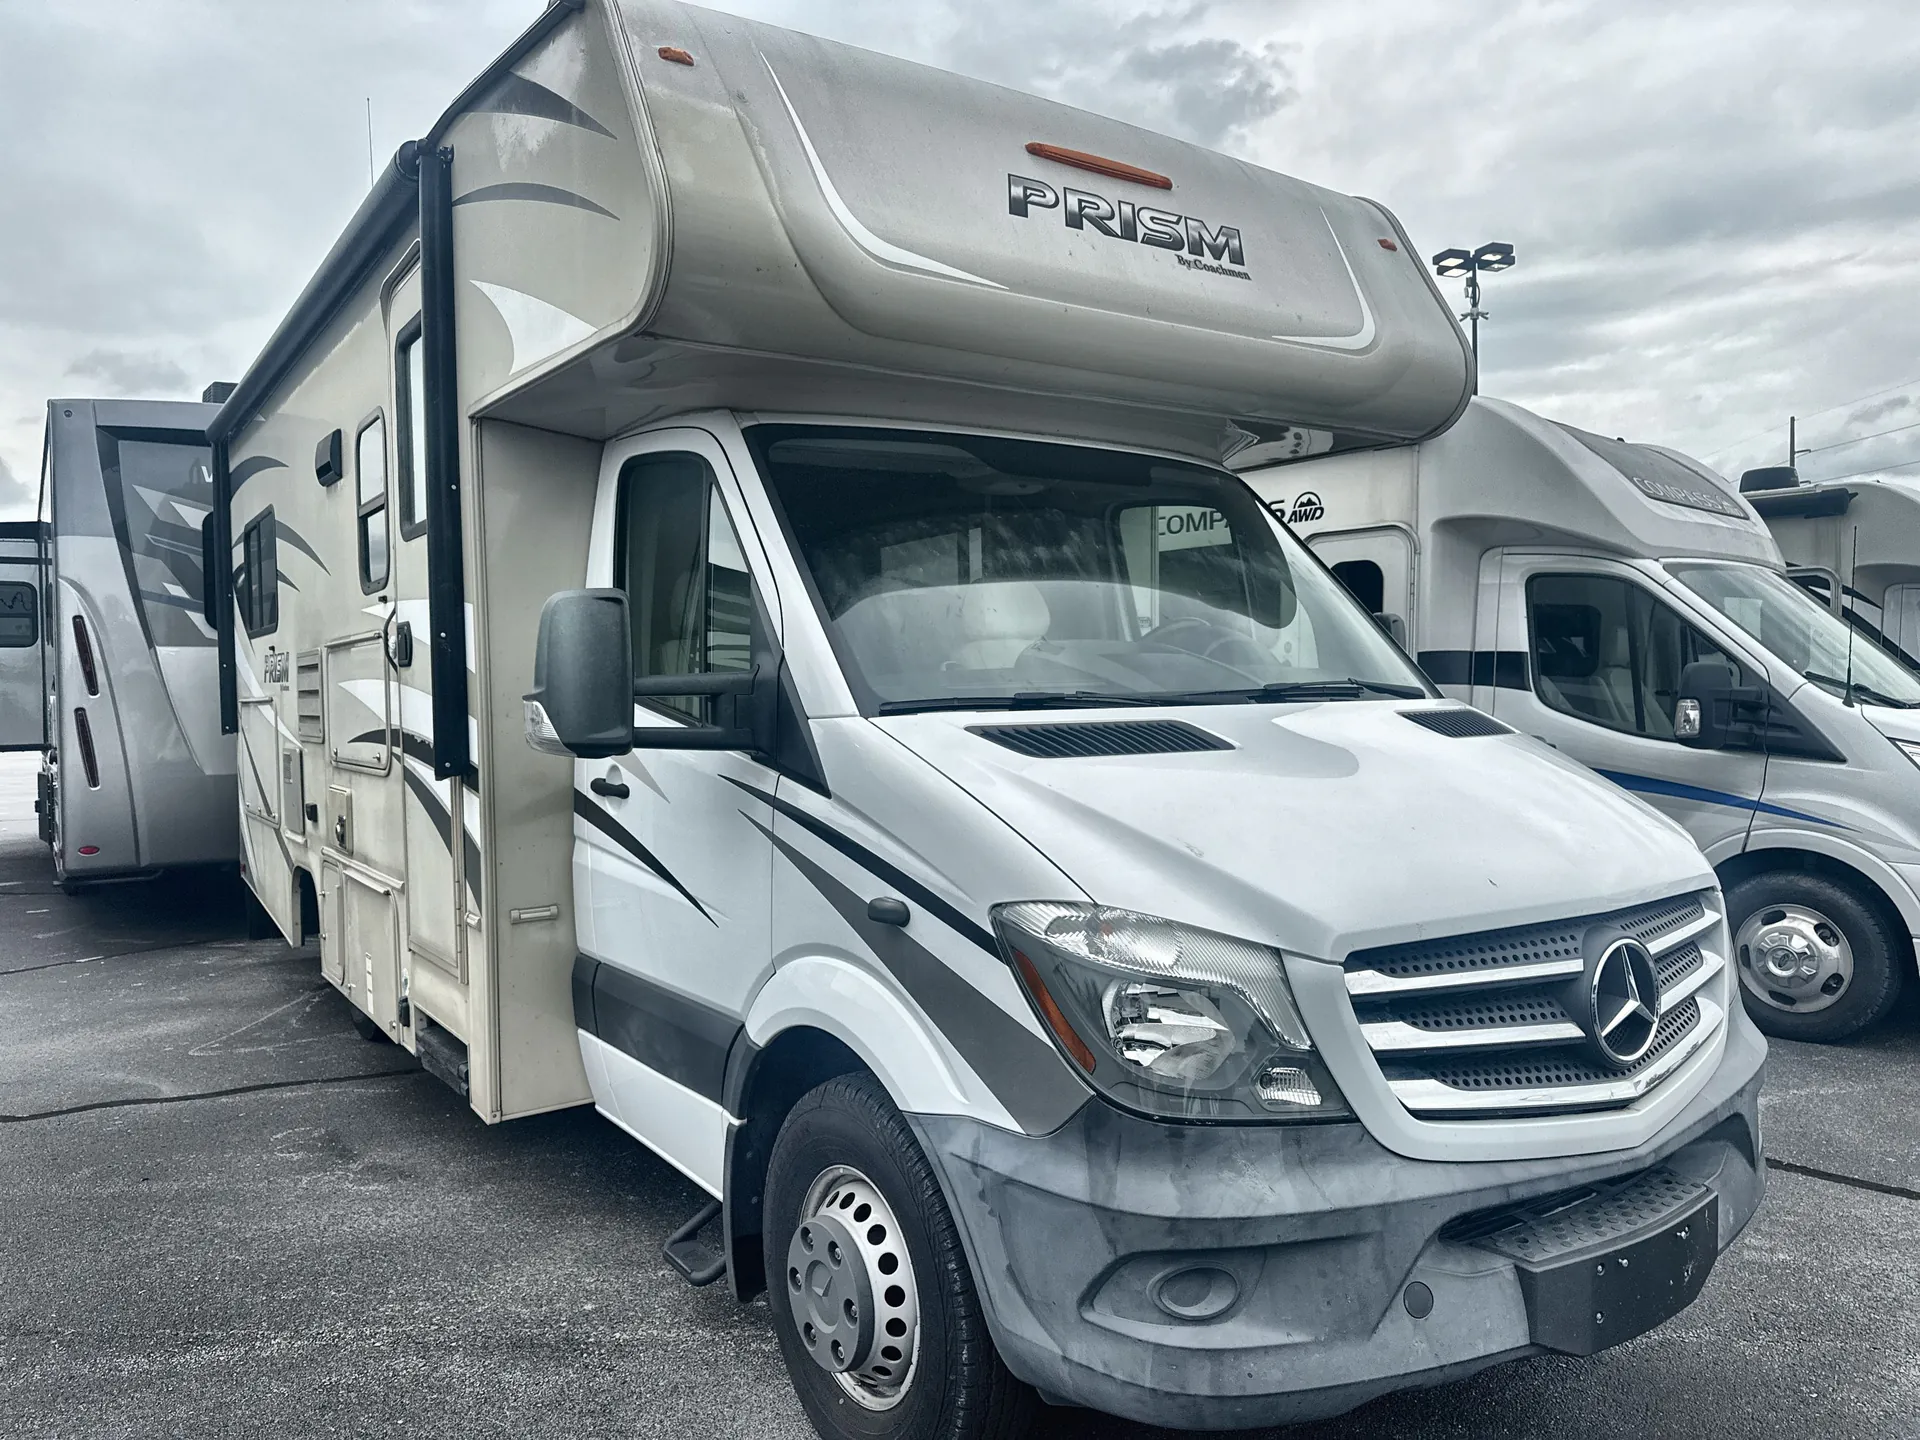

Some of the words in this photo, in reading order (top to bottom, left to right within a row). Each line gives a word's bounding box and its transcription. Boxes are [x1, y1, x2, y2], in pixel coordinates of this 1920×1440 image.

[1008, 173, 1245, 266] PRISM
[1174, 254, 1193, 271] By
[1194, 259, 1252, 281] Coachmen
[1633, 477, 1722, 510] COMPASS
[1287, 506, 1325, 524] AWD
[264, 651, 290, 683] PRISM
